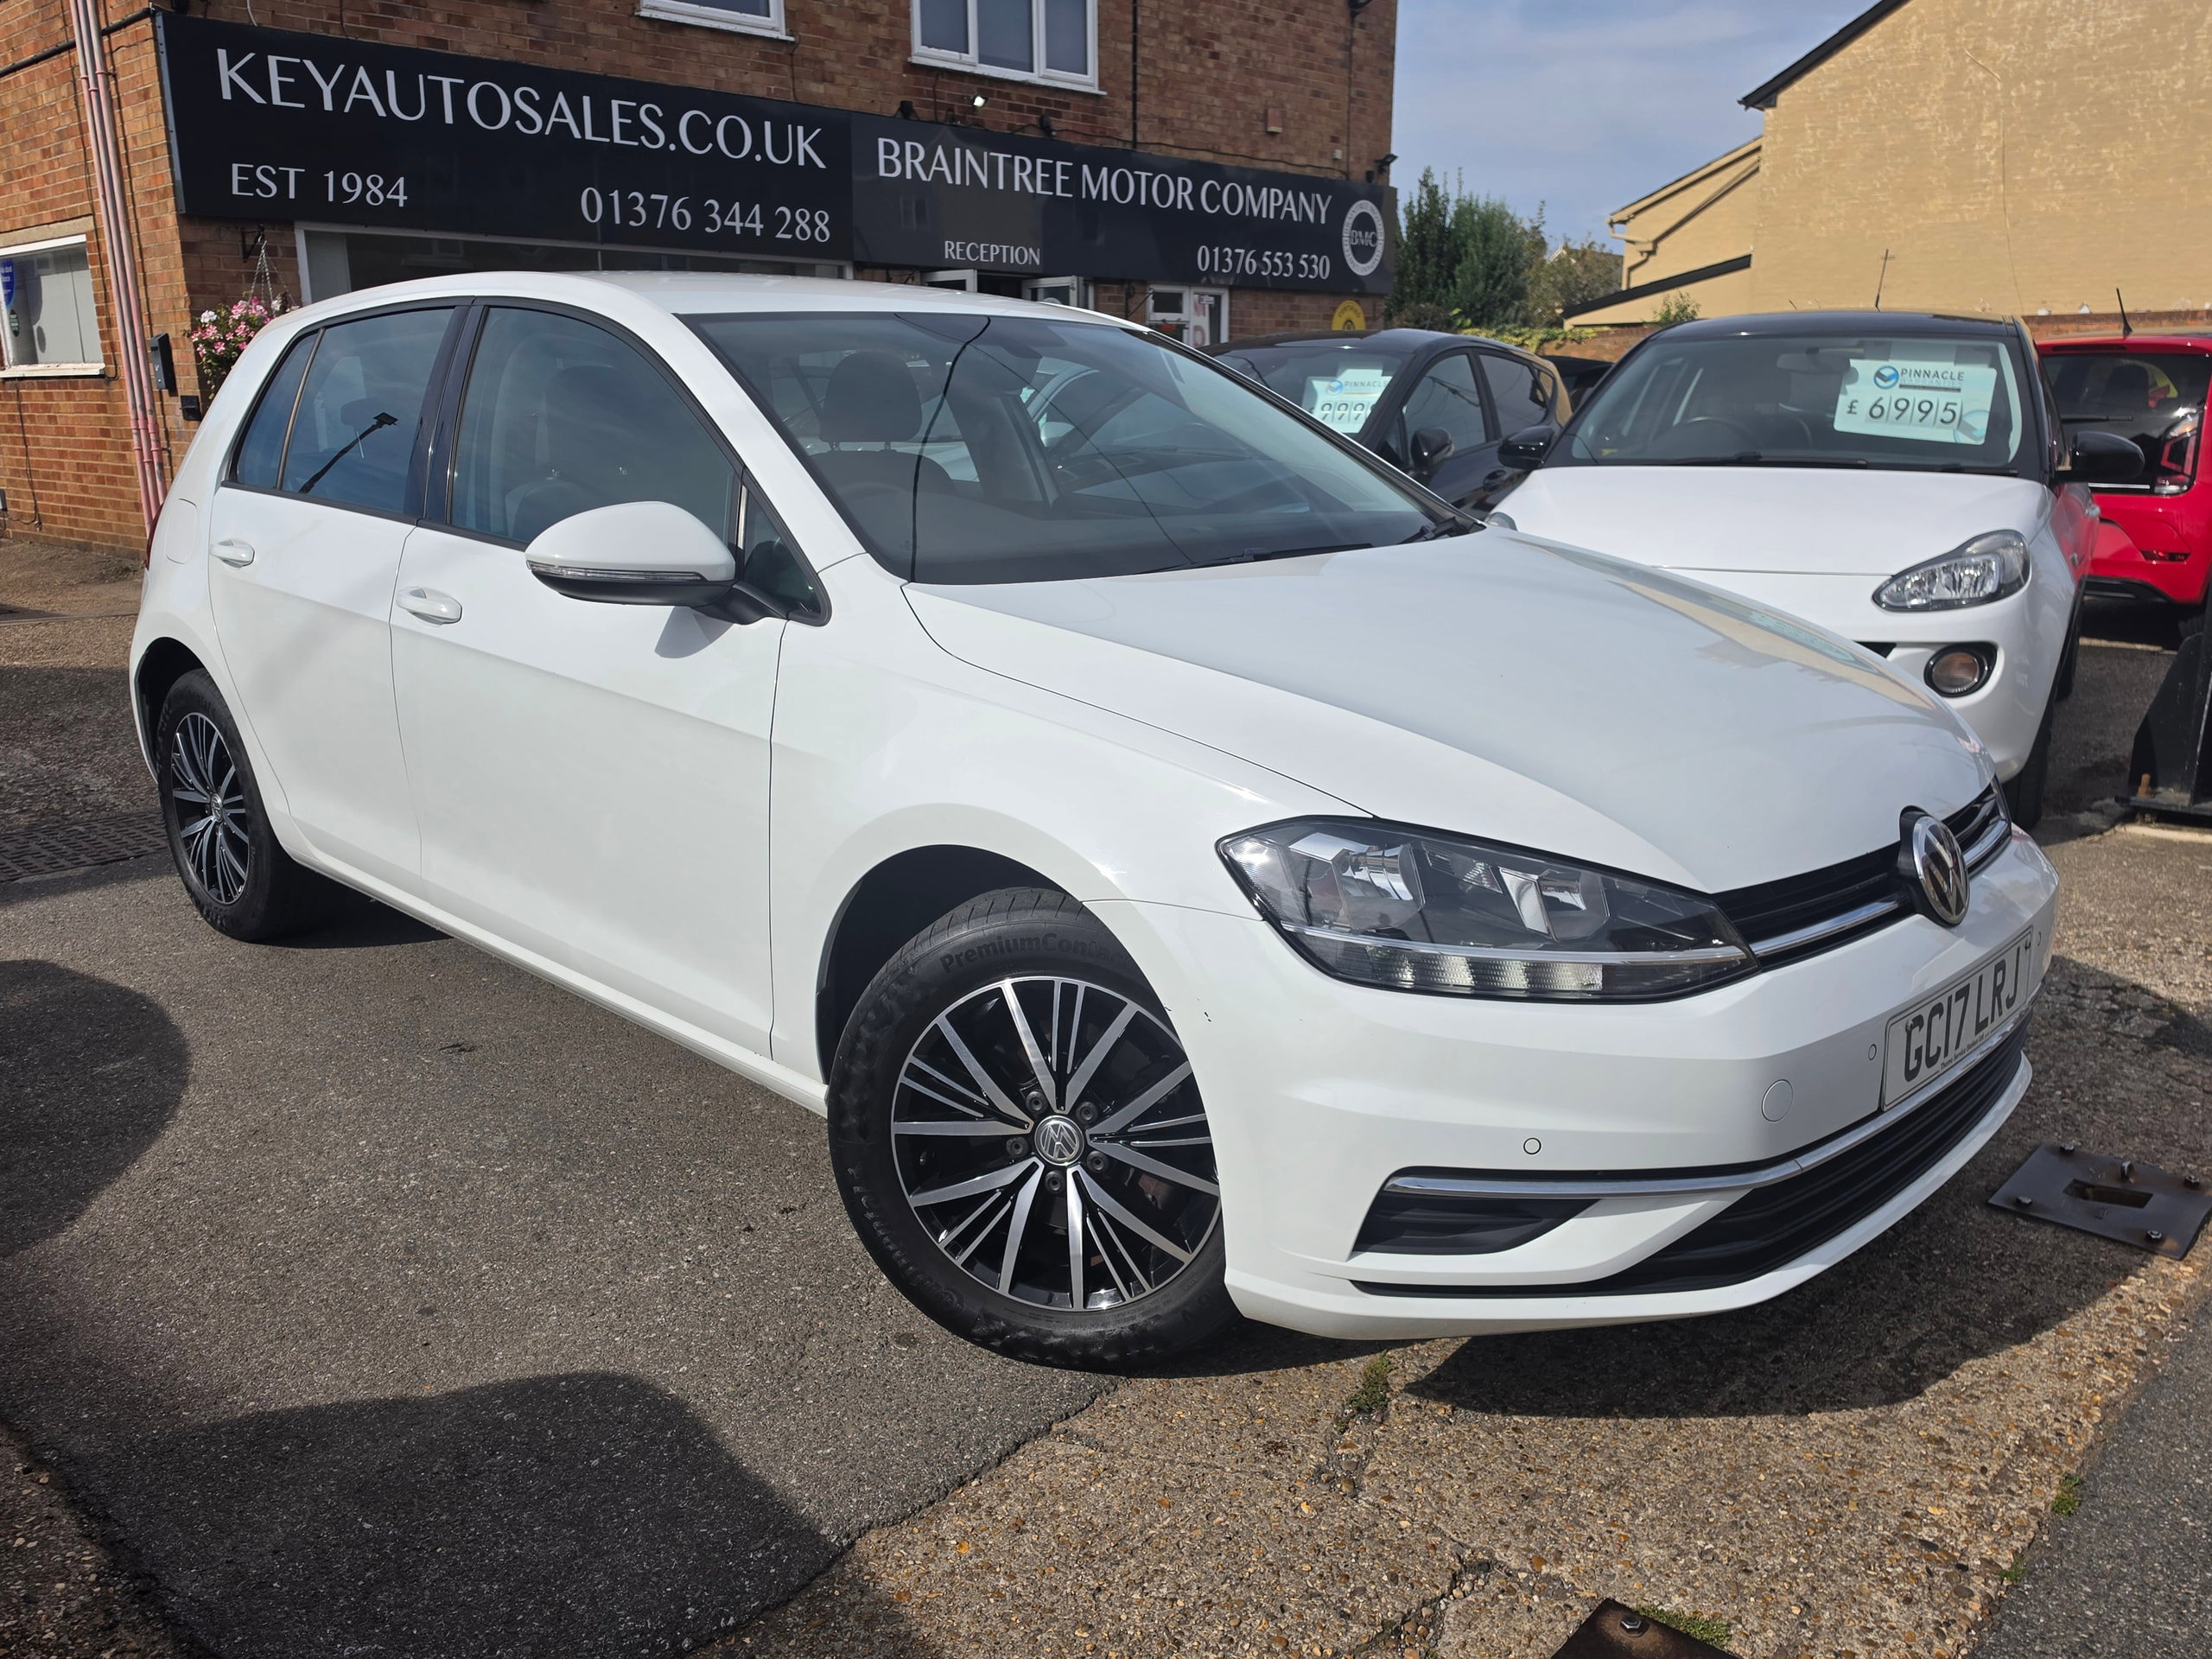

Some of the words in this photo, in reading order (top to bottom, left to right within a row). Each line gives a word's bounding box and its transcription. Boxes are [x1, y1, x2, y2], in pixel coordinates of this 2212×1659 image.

[216, 48, 827, 169] KEYAUTOSALES.CO.UK
[231, 163, 305, 199] EST
[323, 170, 408, 208] 1984
[876, 137, 1073, 198] BRAINTREE
[1081, 164, 1194, 212] MOTOR
[1200, 180, 1332, 225] COMPANY
[581, 187, 691, 231] 01376
[704, 199, 764, 237] 344
[775, 207, 831, 243] 288
[944, 240, 1040, 266] RECEPTION
[1197, 245, 1257, 275] 01376
[1261, 251, 1294, 277] 553
[1298, 254, 1331, 280] 530
[1900, 367, 1965, 382] PINNACLE
[1320, 402, 1376, 422] 999
[1868, 397, 1958, 425] 6995
[1904, 982, 1971, 1083] GC17
[1974, 945, 2021, 1037] LRJ
